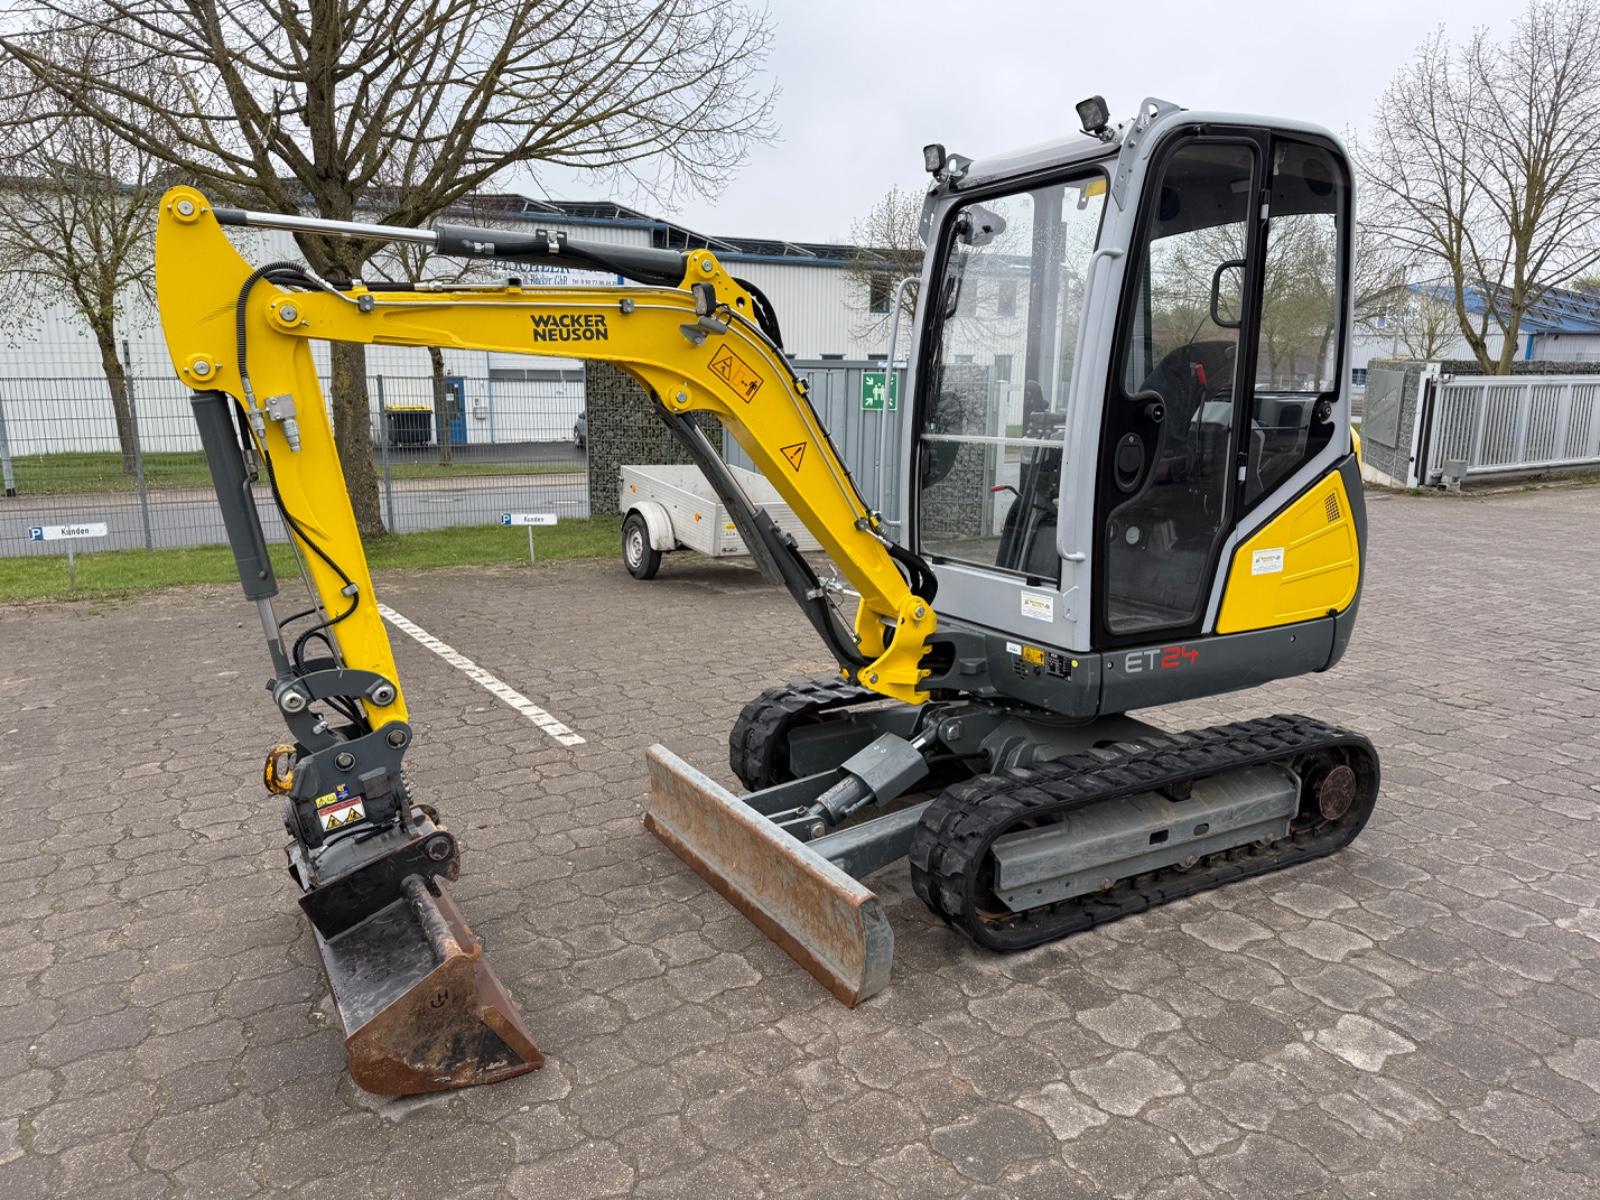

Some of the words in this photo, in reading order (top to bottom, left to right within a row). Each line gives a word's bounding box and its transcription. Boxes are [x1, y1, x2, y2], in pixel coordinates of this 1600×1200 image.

[530, 314, 607, 328] WACKER
[533, 328, 609, 342] NEUSON
[31, 528, 41, 540] P
[61, 527, 90, 536] Kunden
[1125, 645, 1199, 674] ET24
